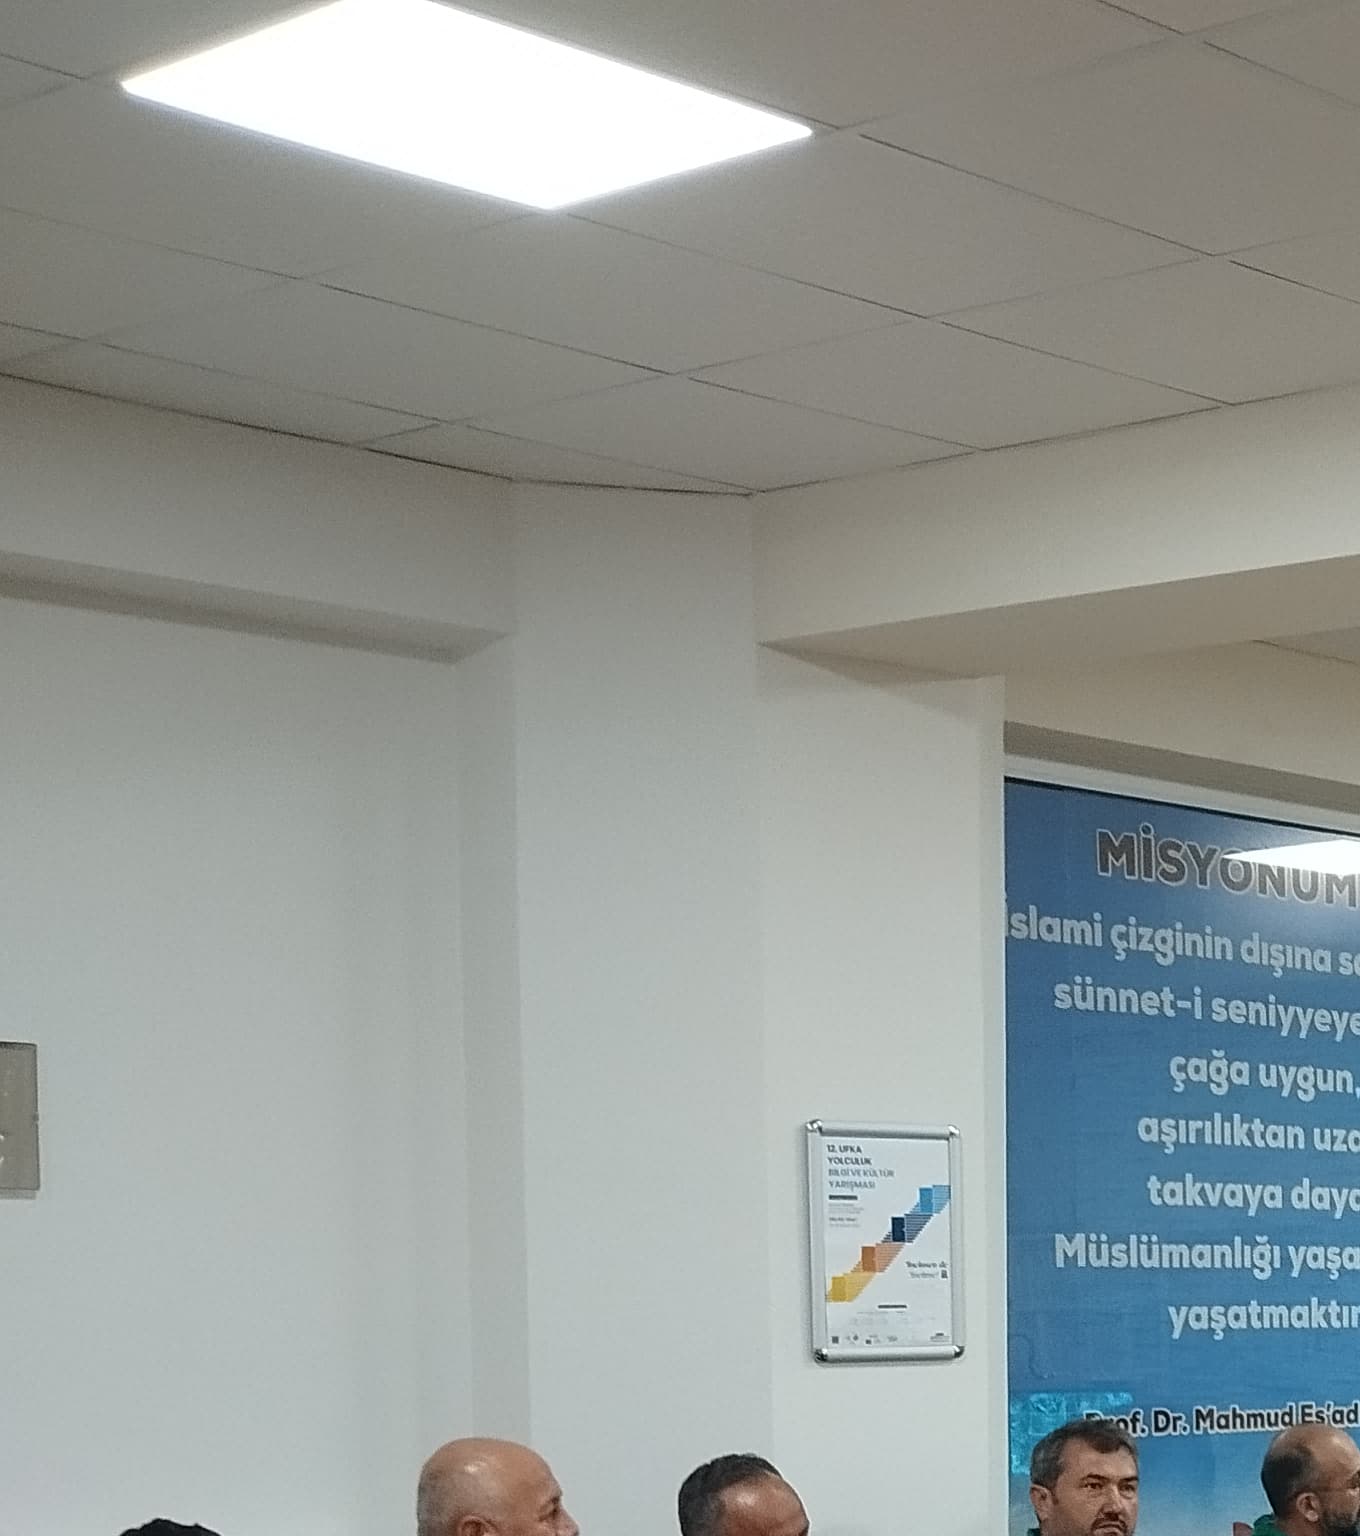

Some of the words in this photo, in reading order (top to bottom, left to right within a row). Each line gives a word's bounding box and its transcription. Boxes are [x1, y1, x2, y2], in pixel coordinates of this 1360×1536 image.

[1110, 915, 1234, 965] çizginin
[1240, 933, 1332, 977] dışına
[1053, 976, 1203, 1019] sünnet-i
[1169, 1050, 1250, 1096] çağa
[1137, 1113, 1305, 1155] aşırılıktan
[1147, 1173, 1283, 1217] takvaya
[1053, 1232, 1282, 1281] Müslümanlığı
[1152, 1407, 1190, 1437] Dr.
[1192, 1402, 1295, 1434] Mahmud
